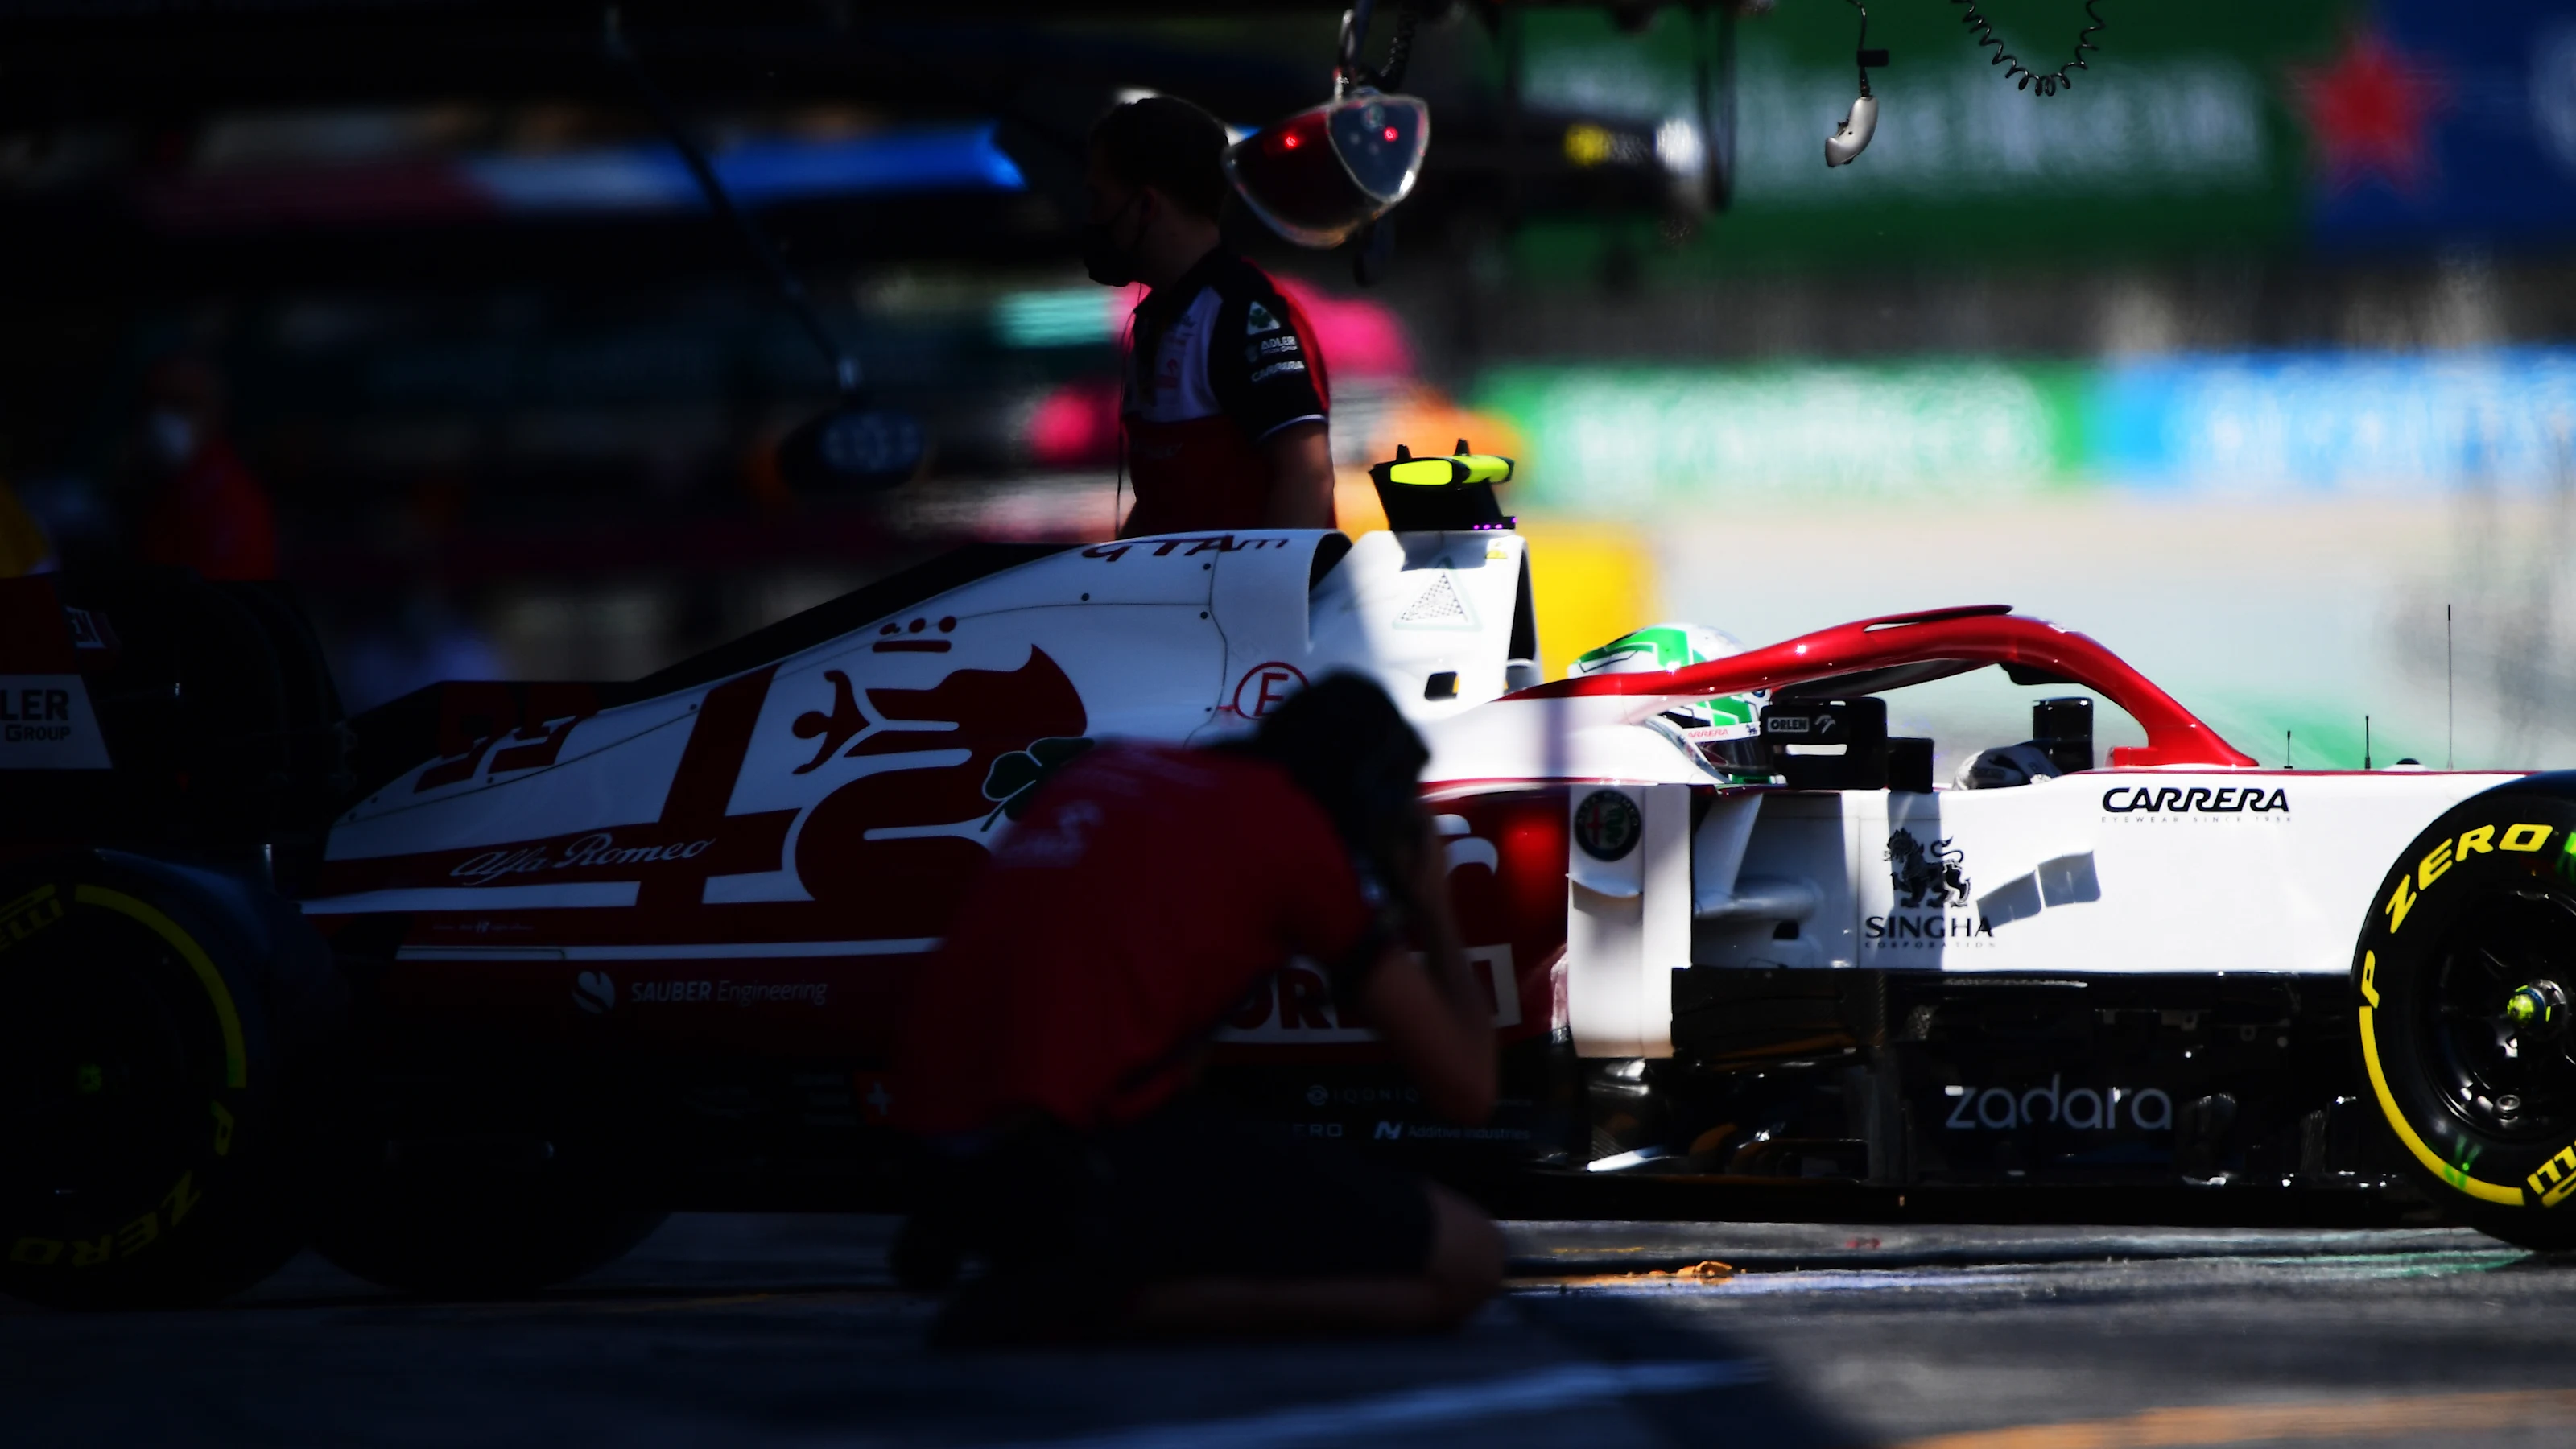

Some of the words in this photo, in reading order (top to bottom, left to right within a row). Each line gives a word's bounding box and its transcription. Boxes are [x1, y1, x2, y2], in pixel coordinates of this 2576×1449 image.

[5, 724, 72, 741] GROUP
[1770, 718, 1807, 730] ORLEN
[2102, 787, 2290, 812] CARRERA
[449, 846, 547, 886] Alfa
[552, 832, 717, 869] Romeo
[1865, 916, 1994, 939] SINGHA
[2359, 948, 2380, 1009] P
[2384, 822, 2554, 935] ZERO
[1864, 941, 1996, 949] CORPORATION
[630, 980, 713, 1003] SAUBER
[716, 978, 830, 1007] Engineering
[1333, 1088, 1419, 1104] IQONIQ
[1944, 1071, 2173, 1130] zadara
[9, 1169, 202, 1269] ZERO
